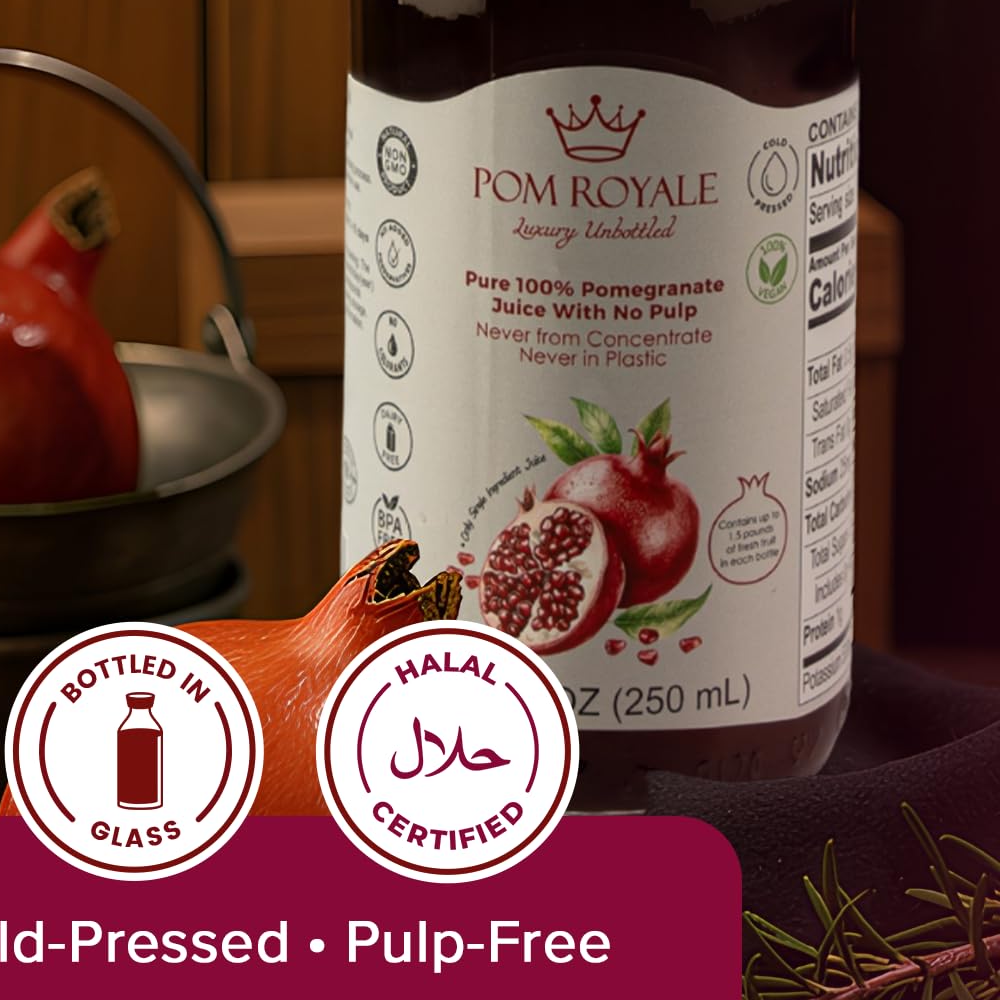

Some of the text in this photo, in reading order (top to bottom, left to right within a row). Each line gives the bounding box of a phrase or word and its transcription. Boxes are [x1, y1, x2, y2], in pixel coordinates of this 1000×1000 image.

[385, 147, 407, 163] NON
[763, 138, 788, 150] COLD
[385, 159, 407, 176] GMO
[475, 168, 718, 208] POM ROYALE
[754, 193, 793, 214] PRESSED
[809, 194, 842, 225] Serving
[513, 215, 677, 250] Luxury Unbottled
[761, 239, 786, 256] 100%
[466, 270, 724, 302] Pure 100% Pomegranate
[758, 284, 787, 300] VEGAN
[492, 299, 697, 324] Juice With No Pulp
[477, 322, 712, 347] Never from Concentrate
[520, 347, 667, 367] Never in Plastic
[808, 358, 830, 387] Total
[381, 408, 402, 424] DAIRY
[382, 450, 400, 466] FREE
[525, 454, 546, 471] Juice
[805, 467, 838, 498] Sodium
[378, 509, 403, 536] BPA
[718, 515, 757, 530] Contains
[805, 505, 829, 536] Total
[804, 614, 834, 646] Protein
[613, 684, 684, 724] (250
[697, 674, 751, 710] mL)
